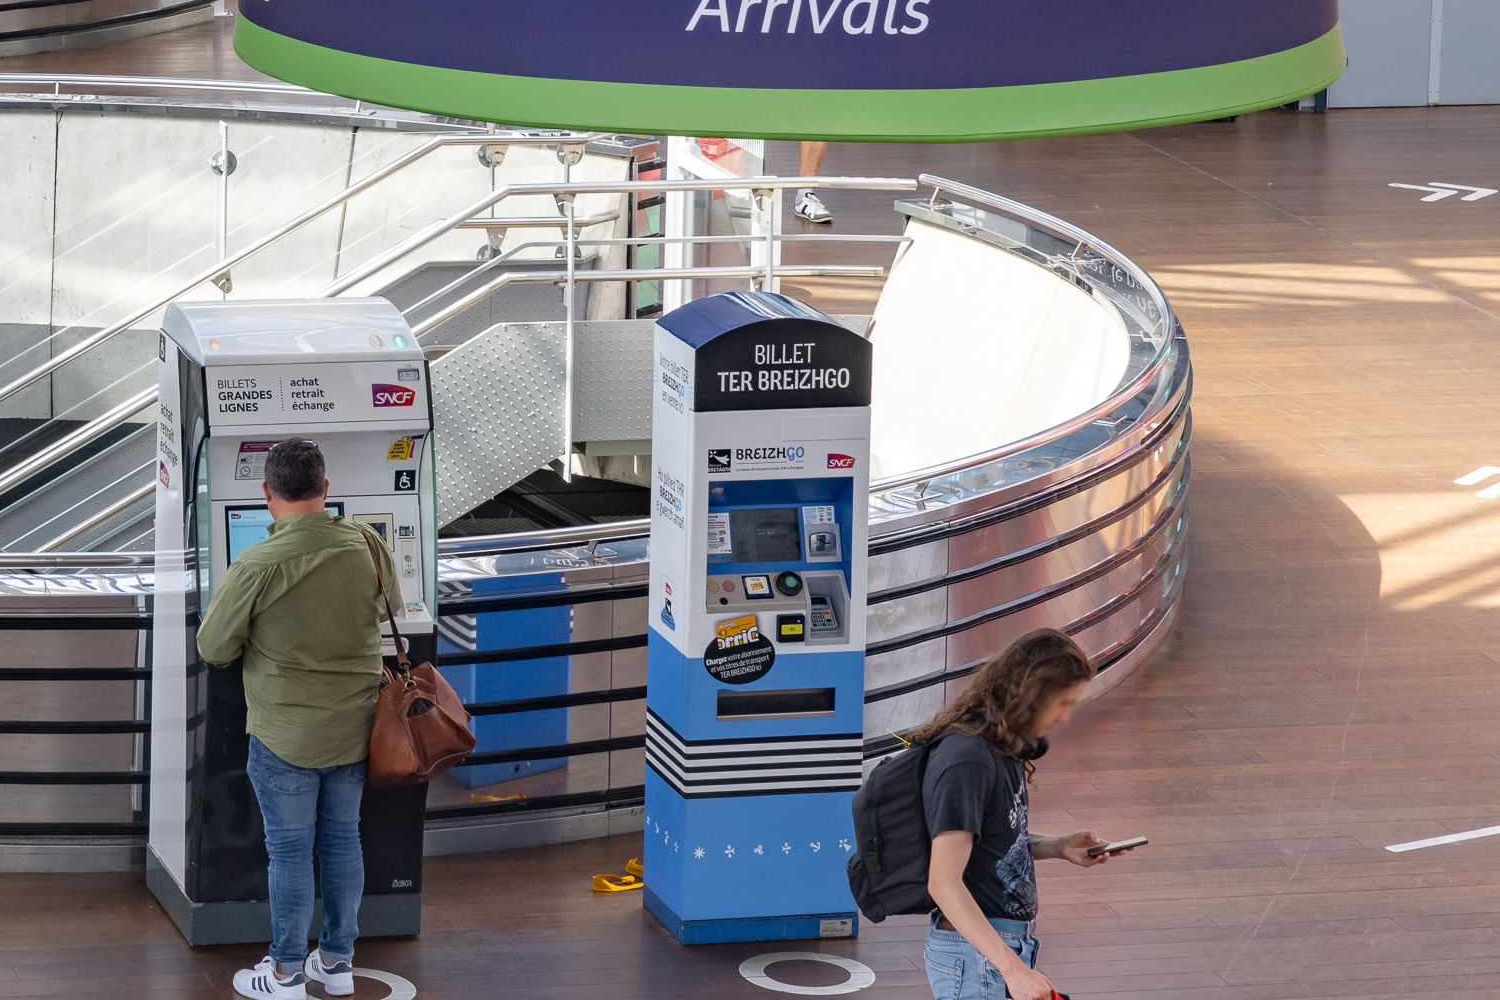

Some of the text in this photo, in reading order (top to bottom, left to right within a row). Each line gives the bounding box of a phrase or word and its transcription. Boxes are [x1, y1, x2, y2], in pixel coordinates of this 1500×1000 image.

[755, 343, 815, 365] BILLET
[681, 364, 689, 384] TER
[718, 368, 850, 392] TER BREIZHGO
[217, 377, 319, 389] BILLETS achat
[662, 372, 685, 397] BREIZHGO
[218, 388, 325, 401] GRANDES retrait
[375, 392, 413, 404] SNCF
[219, 400, 335, 413] LIGNES échange
[828, 458, 853, 467] SNCF
[706, 646, 772, 666] Chargez votre abonnement
[726, 661, 738, 670] titres
[746, 655, 770, 665] transport
[720, 670, 731, 679] TER
[731, 665, 756, 676] BREIZHGO
